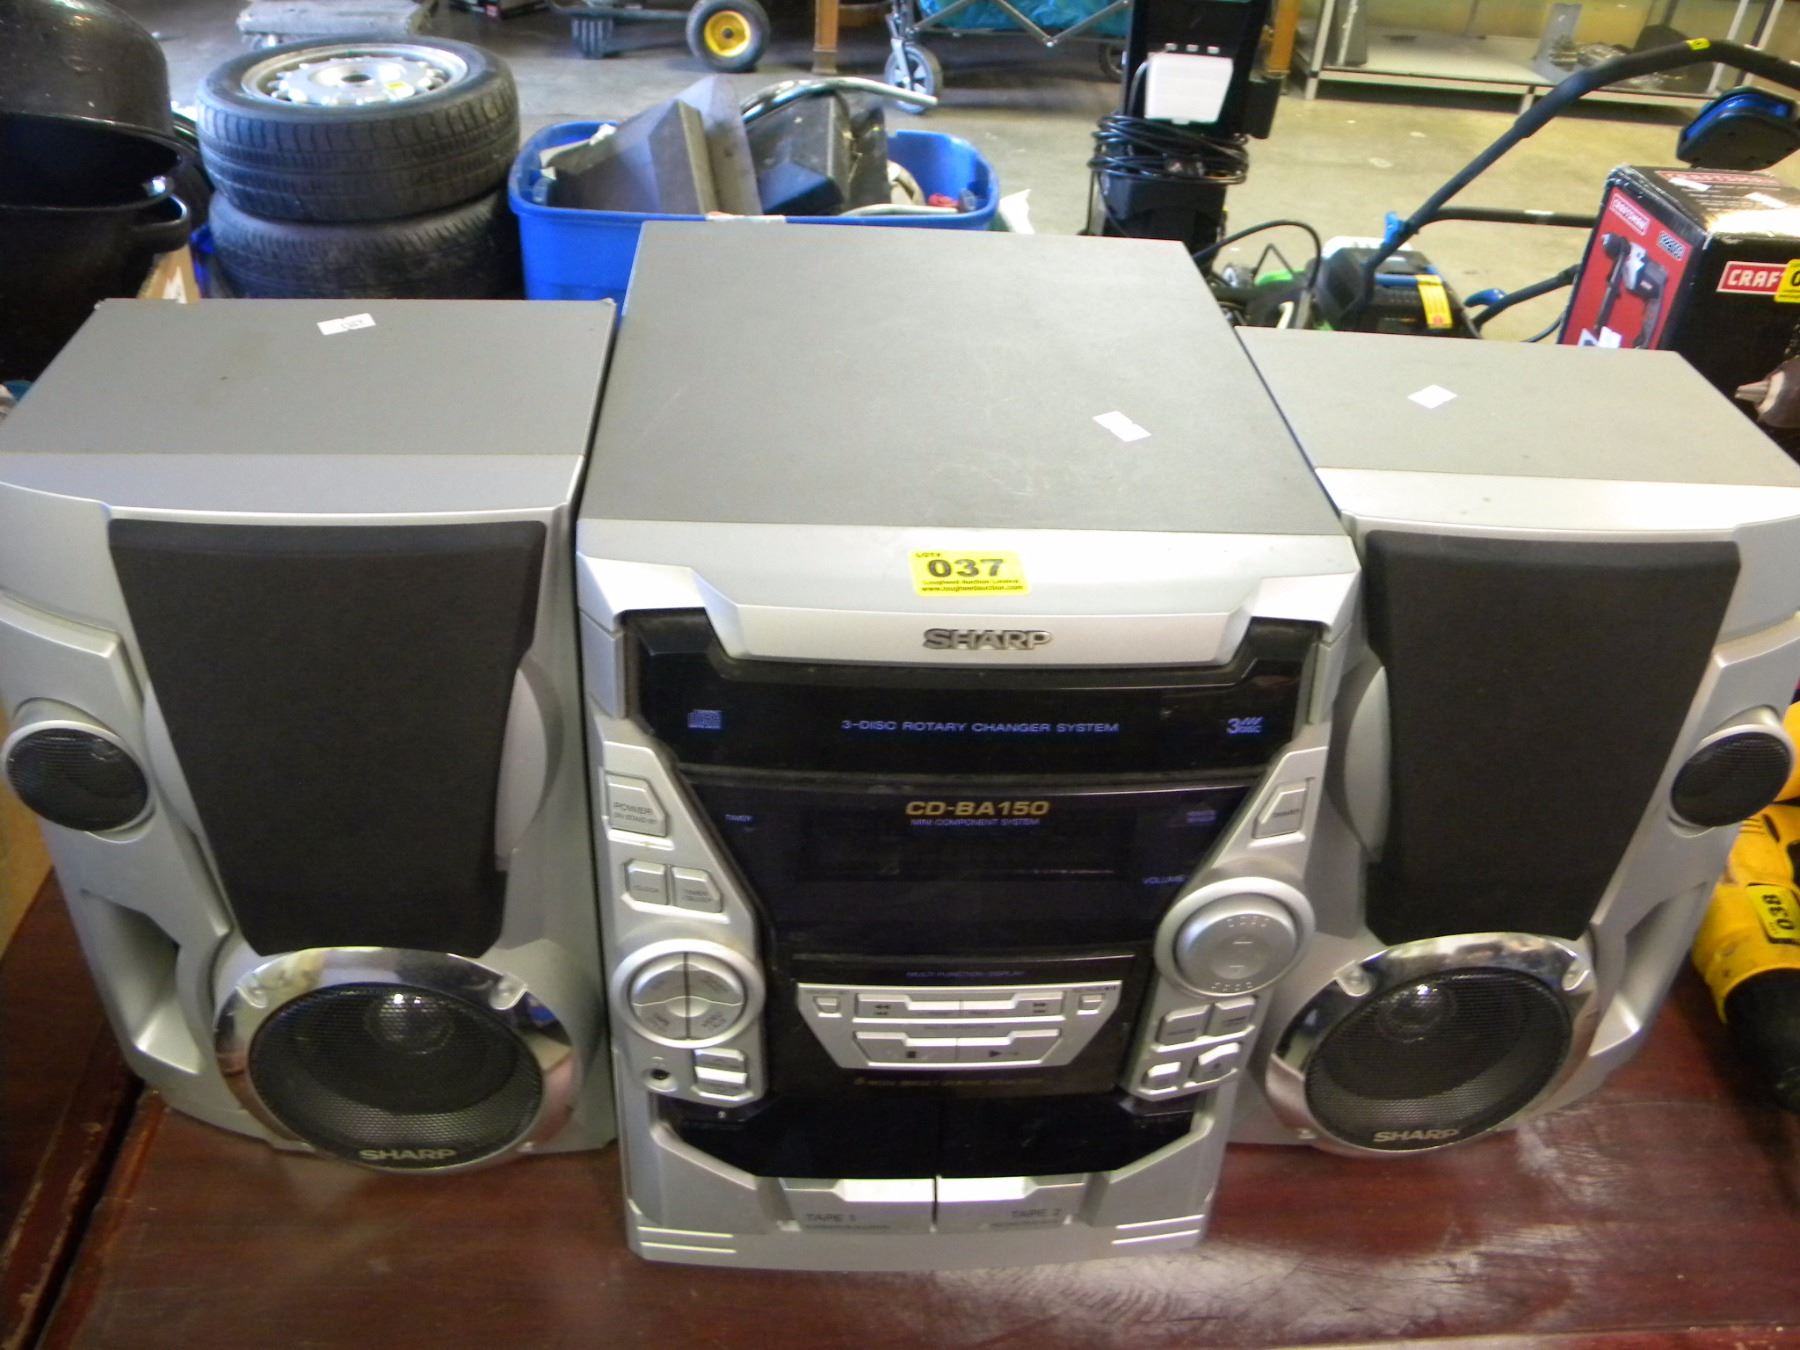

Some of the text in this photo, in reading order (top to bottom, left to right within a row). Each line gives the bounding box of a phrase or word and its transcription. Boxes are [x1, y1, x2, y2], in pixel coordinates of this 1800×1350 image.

[927, 558, 1004, 578] 037
[923, 628, 1053, 650] SHARP
[841, 720, 1120, 733] 3-DISC ROTARY CHANGER SYSTEM
[905, 801, 1050, 816] CD-BA150
[1373, 1128, 1460, 1142] SHARP
[359, 1148, 458, 1160] SHARP
[806, 1212, 843, 1223] TAPE
